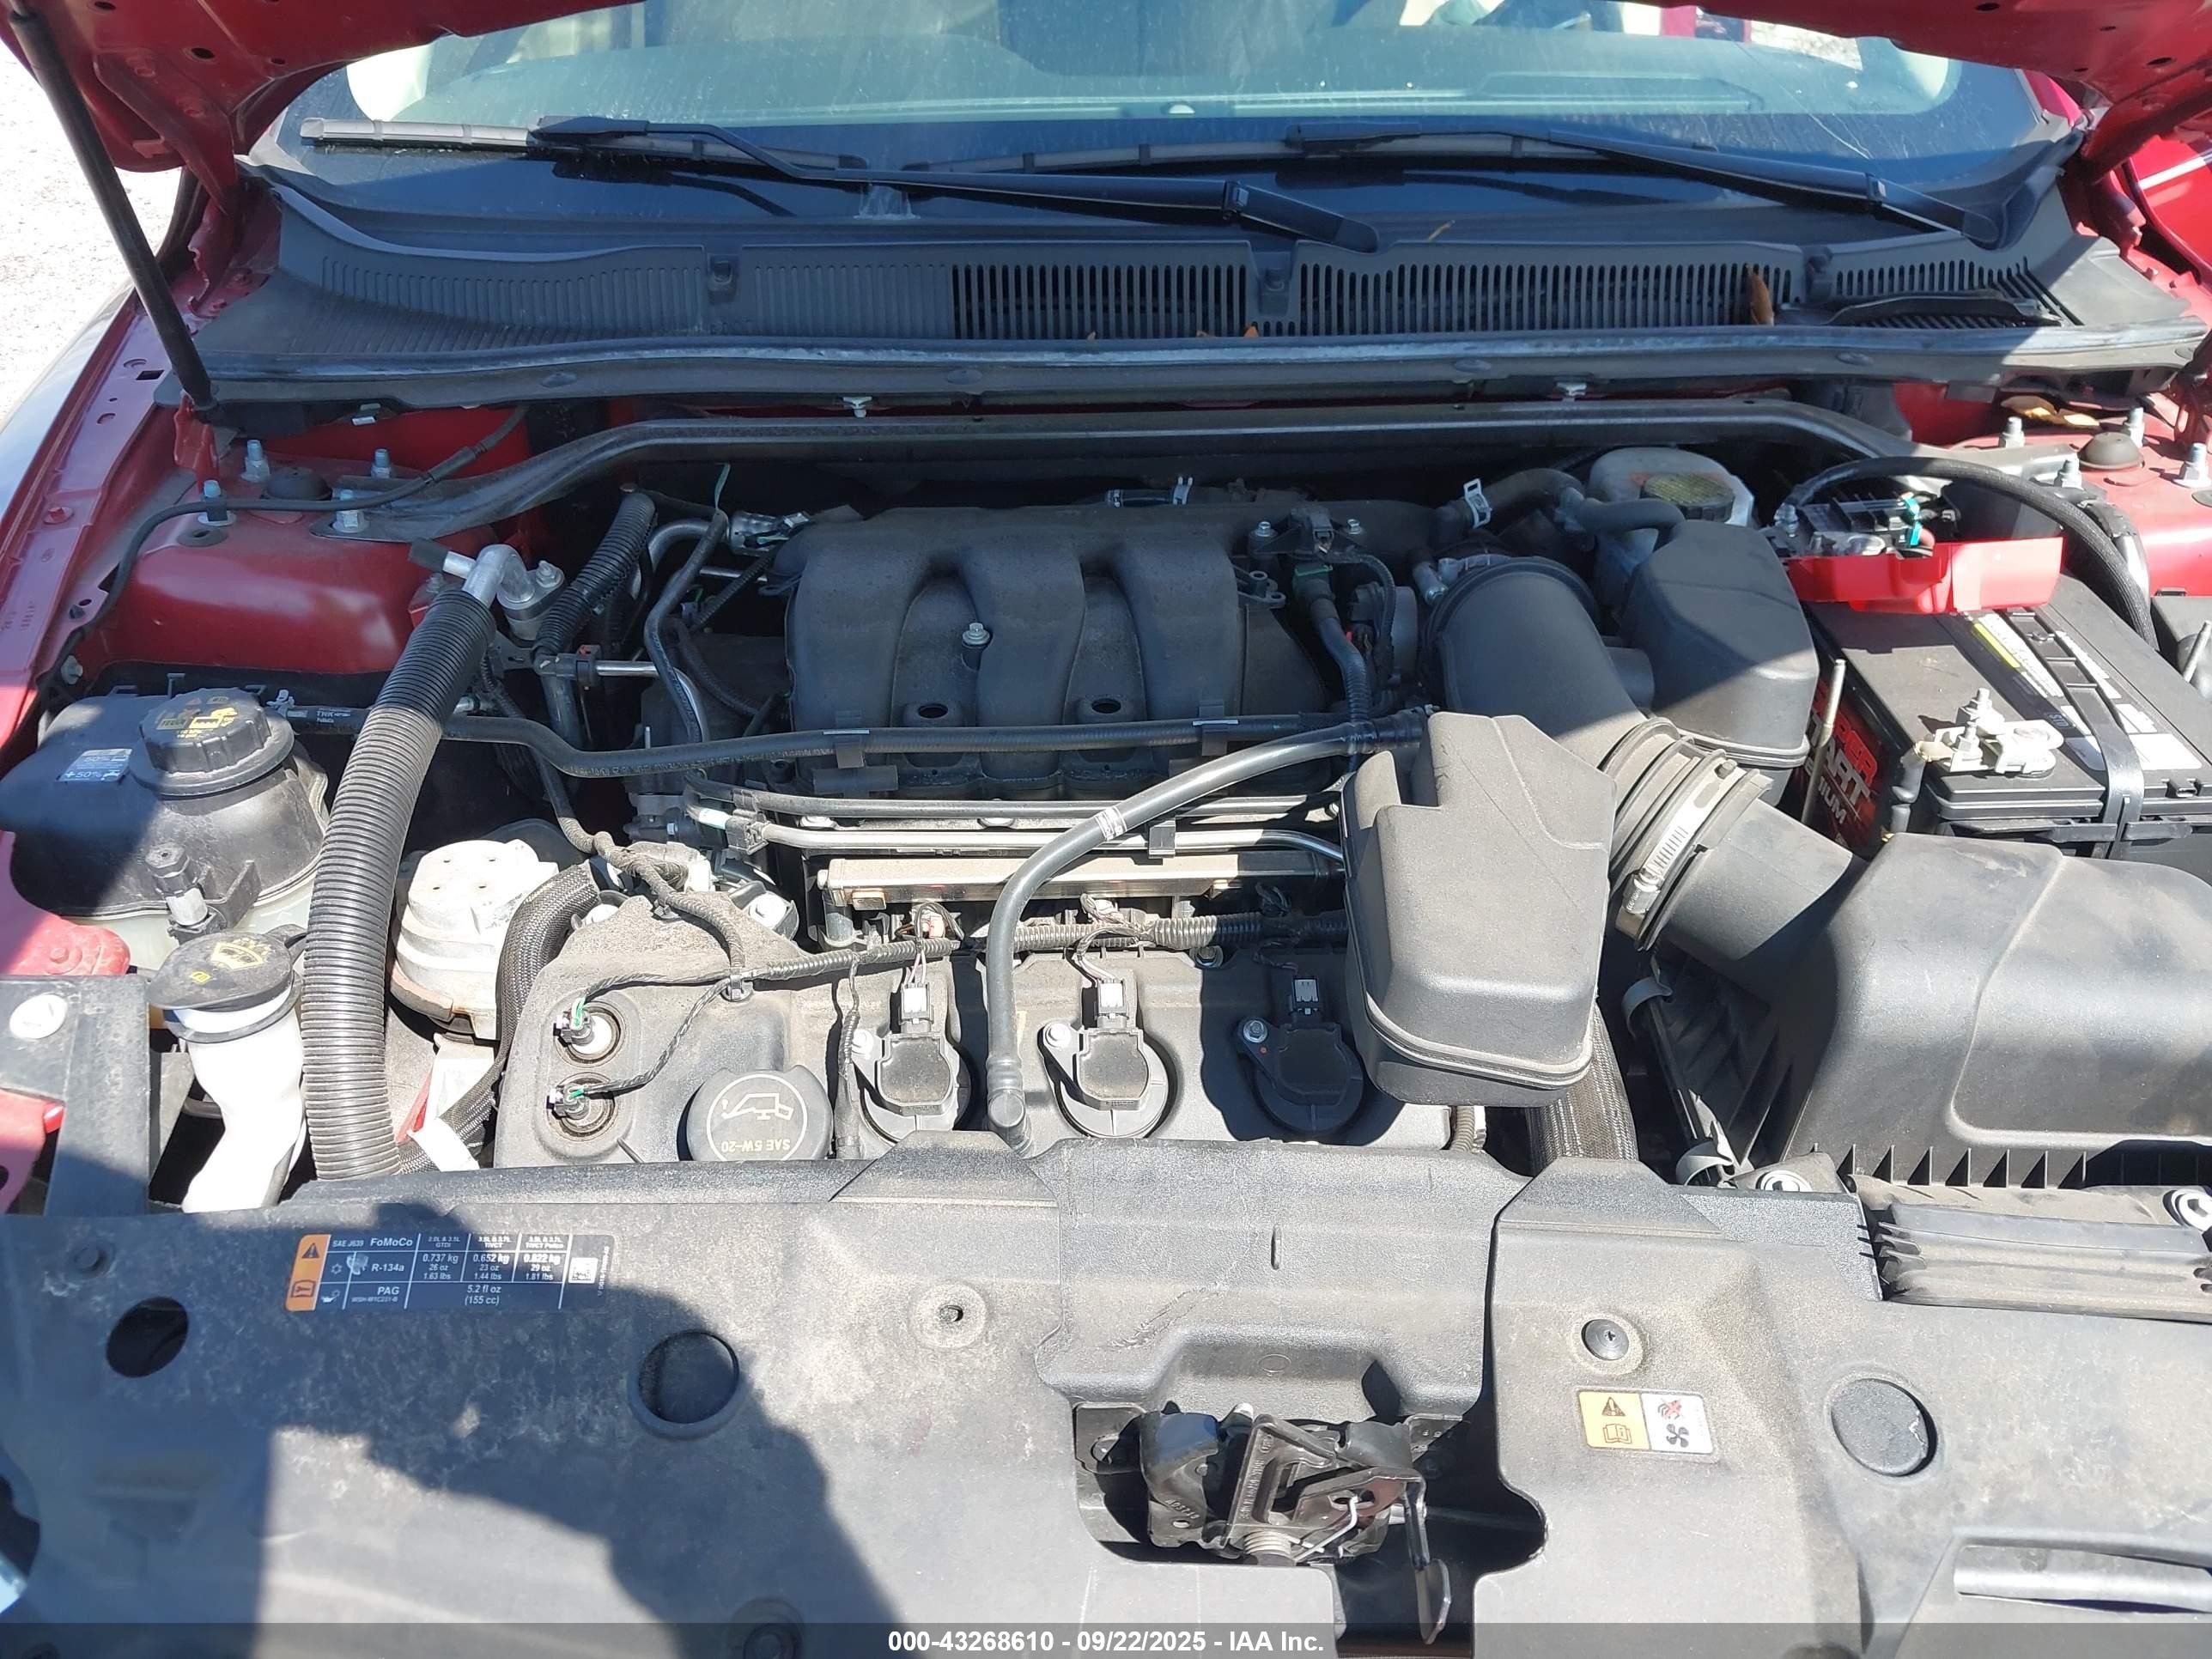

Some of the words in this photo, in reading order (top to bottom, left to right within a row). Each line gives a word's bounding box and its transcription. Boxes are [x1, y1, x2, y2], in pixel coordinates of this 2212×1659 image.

[721, 1139, 763, 1152] 5W-20
[766, 1139, 790, 1151] SAE
[370, 1237, 413, 1247] FoMoCo
[422, 1254, 446, 1262] 0.737
[447, 1254, 459, 1264] kg
[473, 1254, 497, 1262] 0.652
[497, 1254, 510, 1264] kg
[378, 1286, 400, 1295] PAG
[467, 1284, 481, 1293] 5.2
[482, 1284, 489, 1293] fl
[465, 1296, 484, 1305] (155
[485, 1296, 500, 1305] cc)
